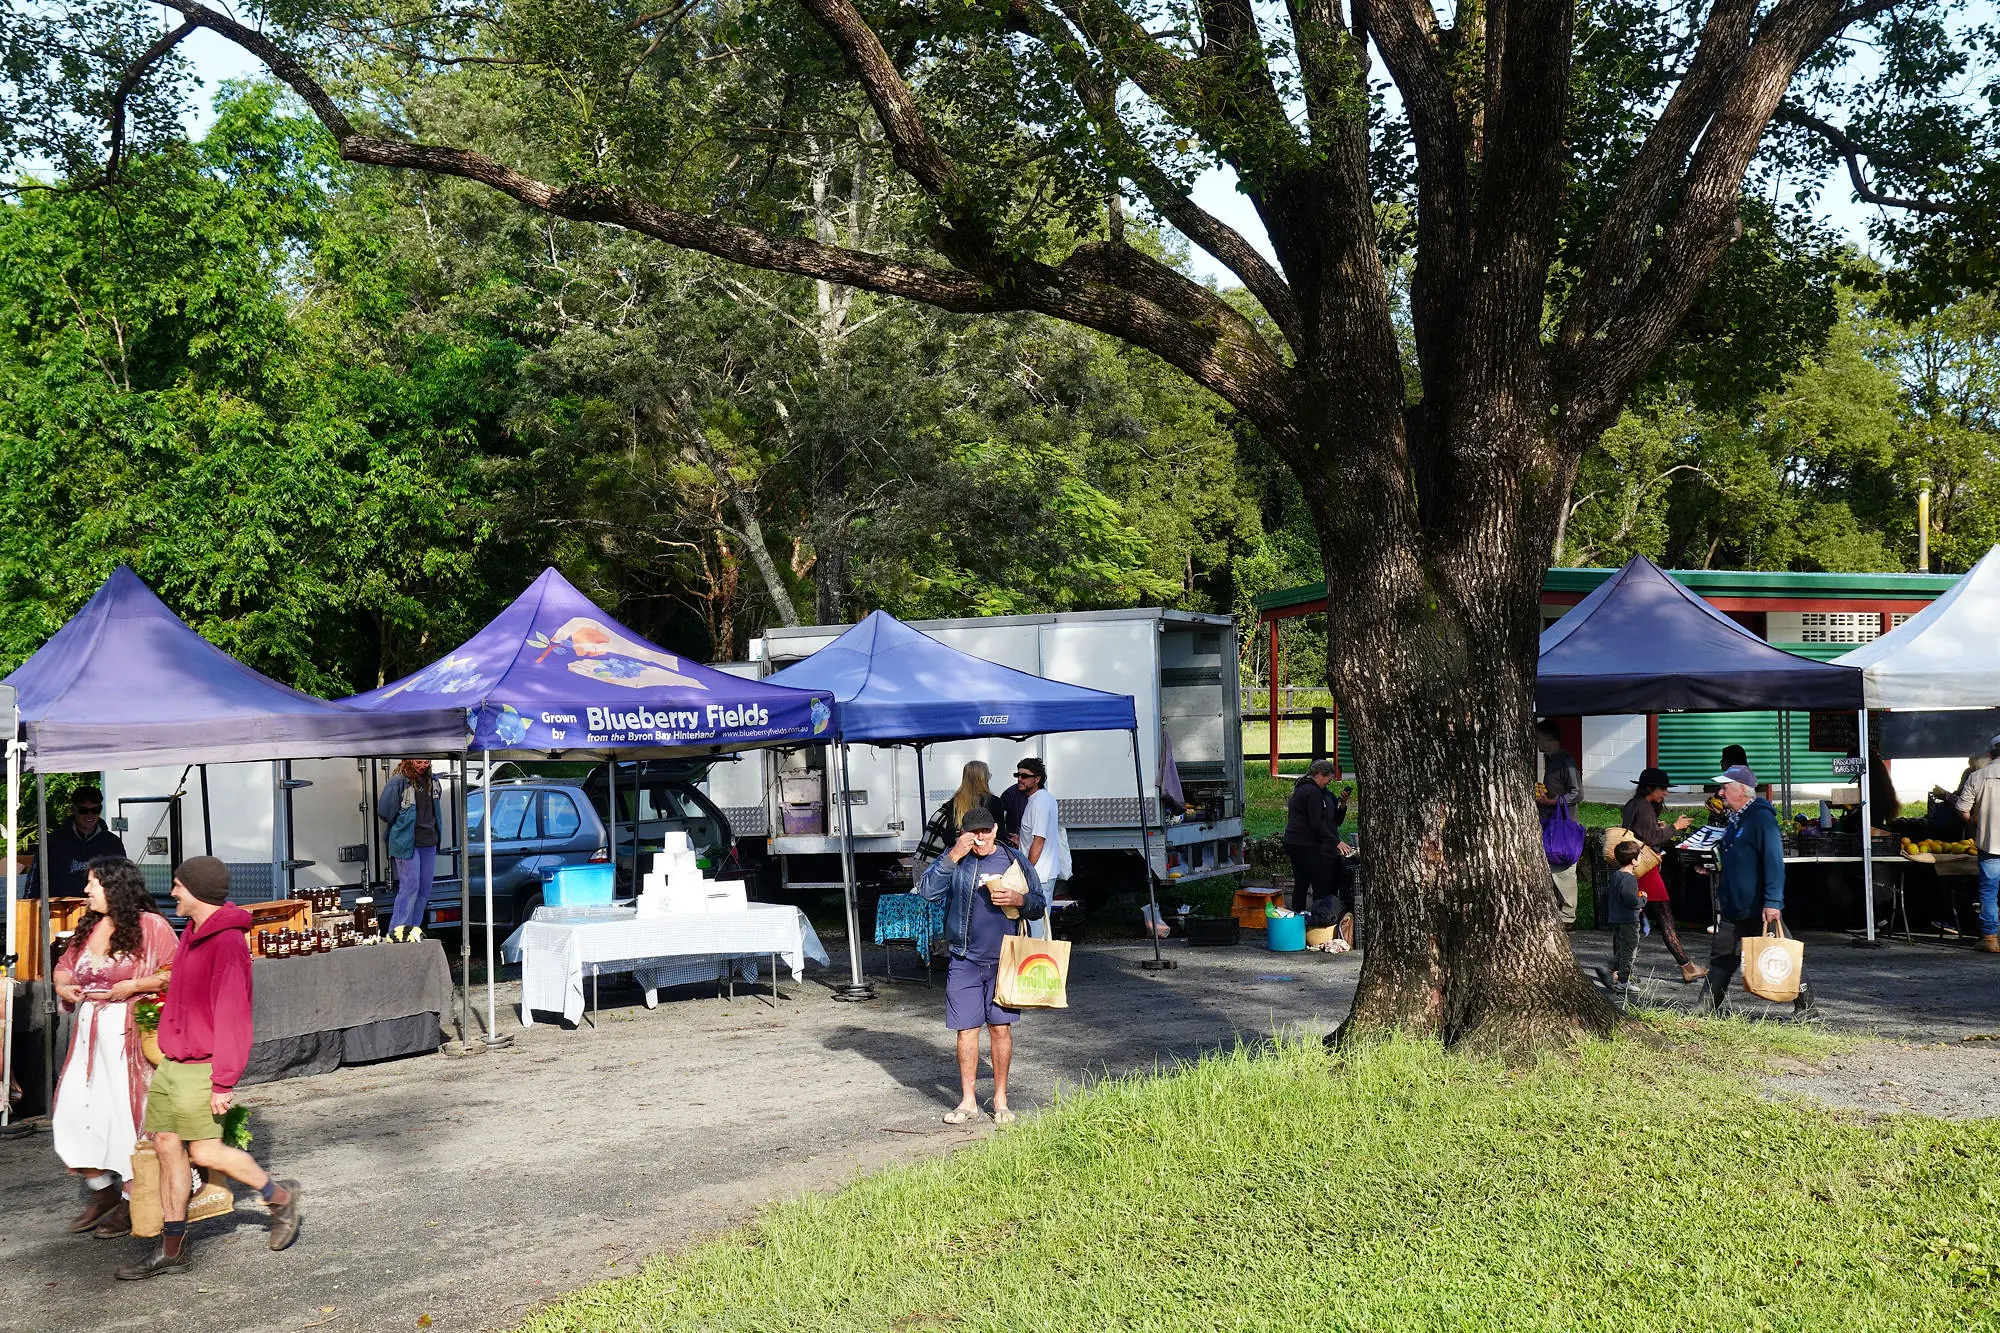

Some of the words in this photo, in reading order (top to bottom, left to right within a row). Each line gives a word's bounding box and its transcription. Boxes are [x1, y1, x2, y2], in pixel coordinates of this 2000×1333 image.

[541, 711, 577, 724] Grown
[586, 705, 698, 731] Blueberry
[706, 703, 769, 729] Fields
[979, 715, 1009, 725] KINGS
[551, 727, 566, 740] by
[587, 732, 608, 742] from
[610, 732, 625, 742] the
[628, 731, 653, 741] Byron
[655, 730, 671, 740] Bay
[673, 729, 715, 740] Hinterland
[722, 726, 809, 738] www.blueberryfields.com.au
